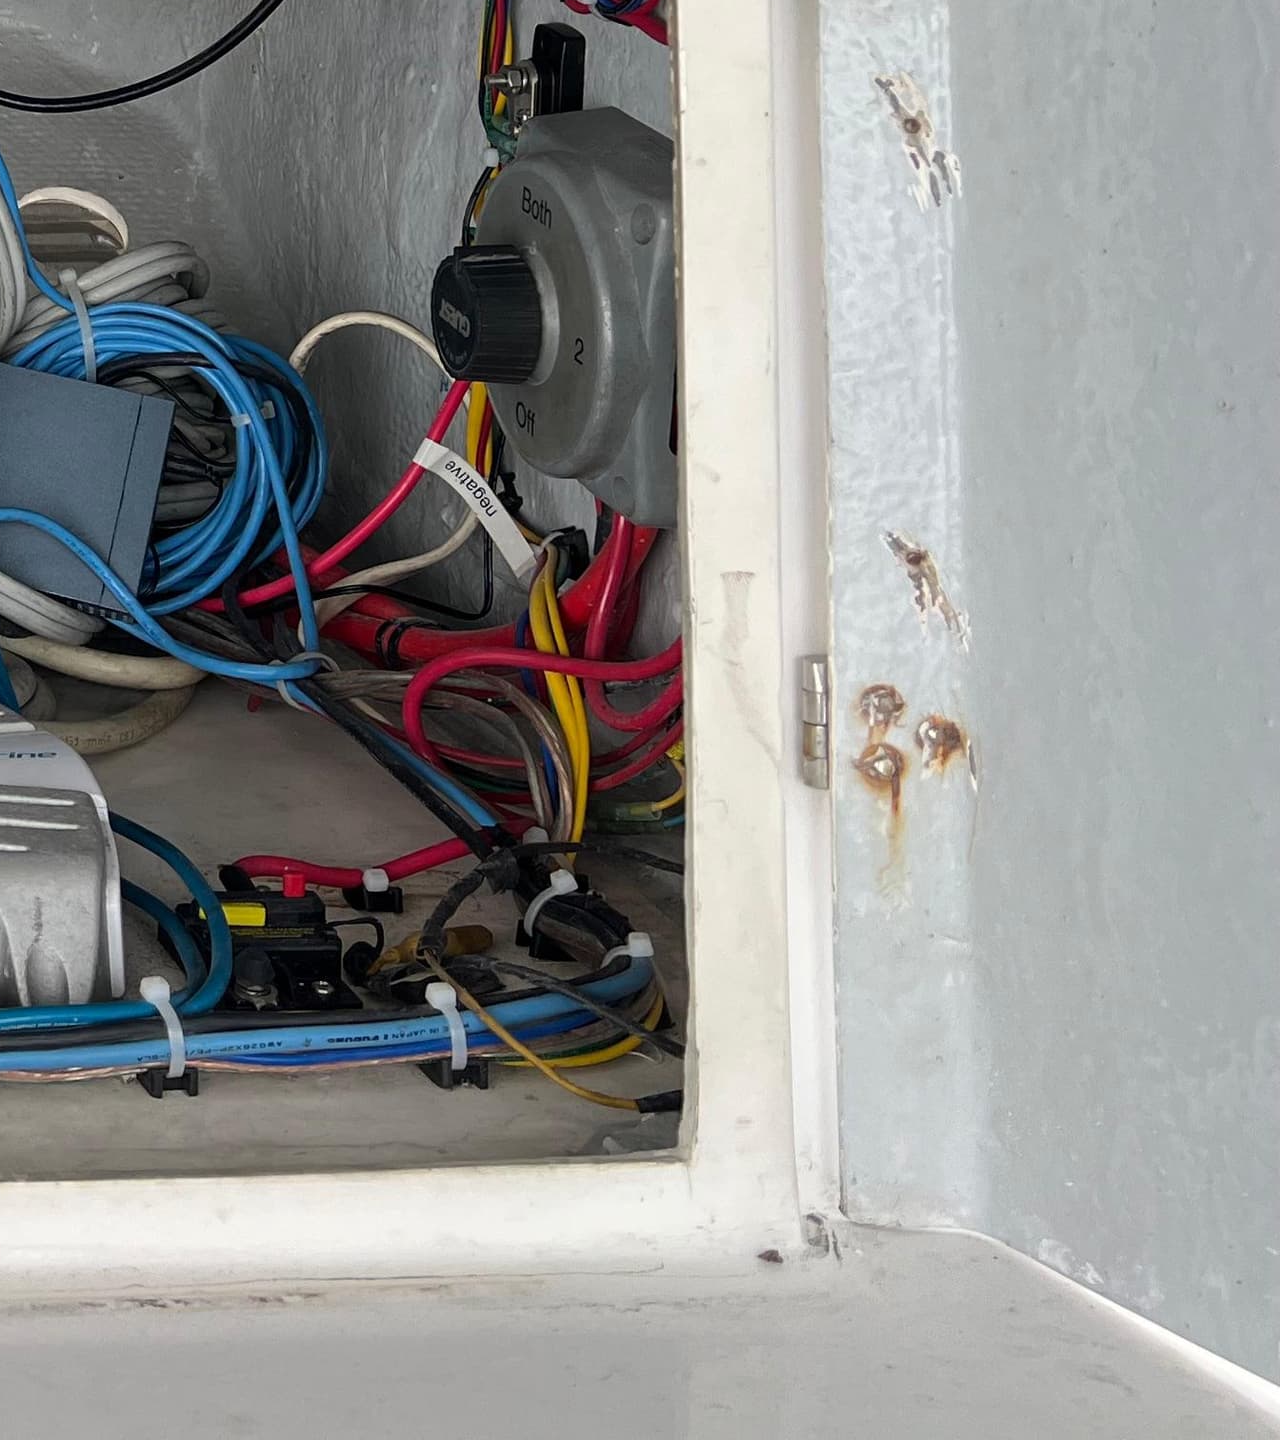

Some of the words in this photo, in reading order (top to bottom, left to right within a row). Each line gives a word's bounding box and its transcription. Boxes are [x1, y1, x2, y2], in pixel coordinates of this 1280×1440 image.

[521, 186, 552, 229] Both
[439, 298, 472, 339] GUEST
[574, 337, 584, 365] 2
[515, 401, 536, 437] Off
[444, 459, 498, 518] negative
[391, 1029, 426, 1041] JAPAN
